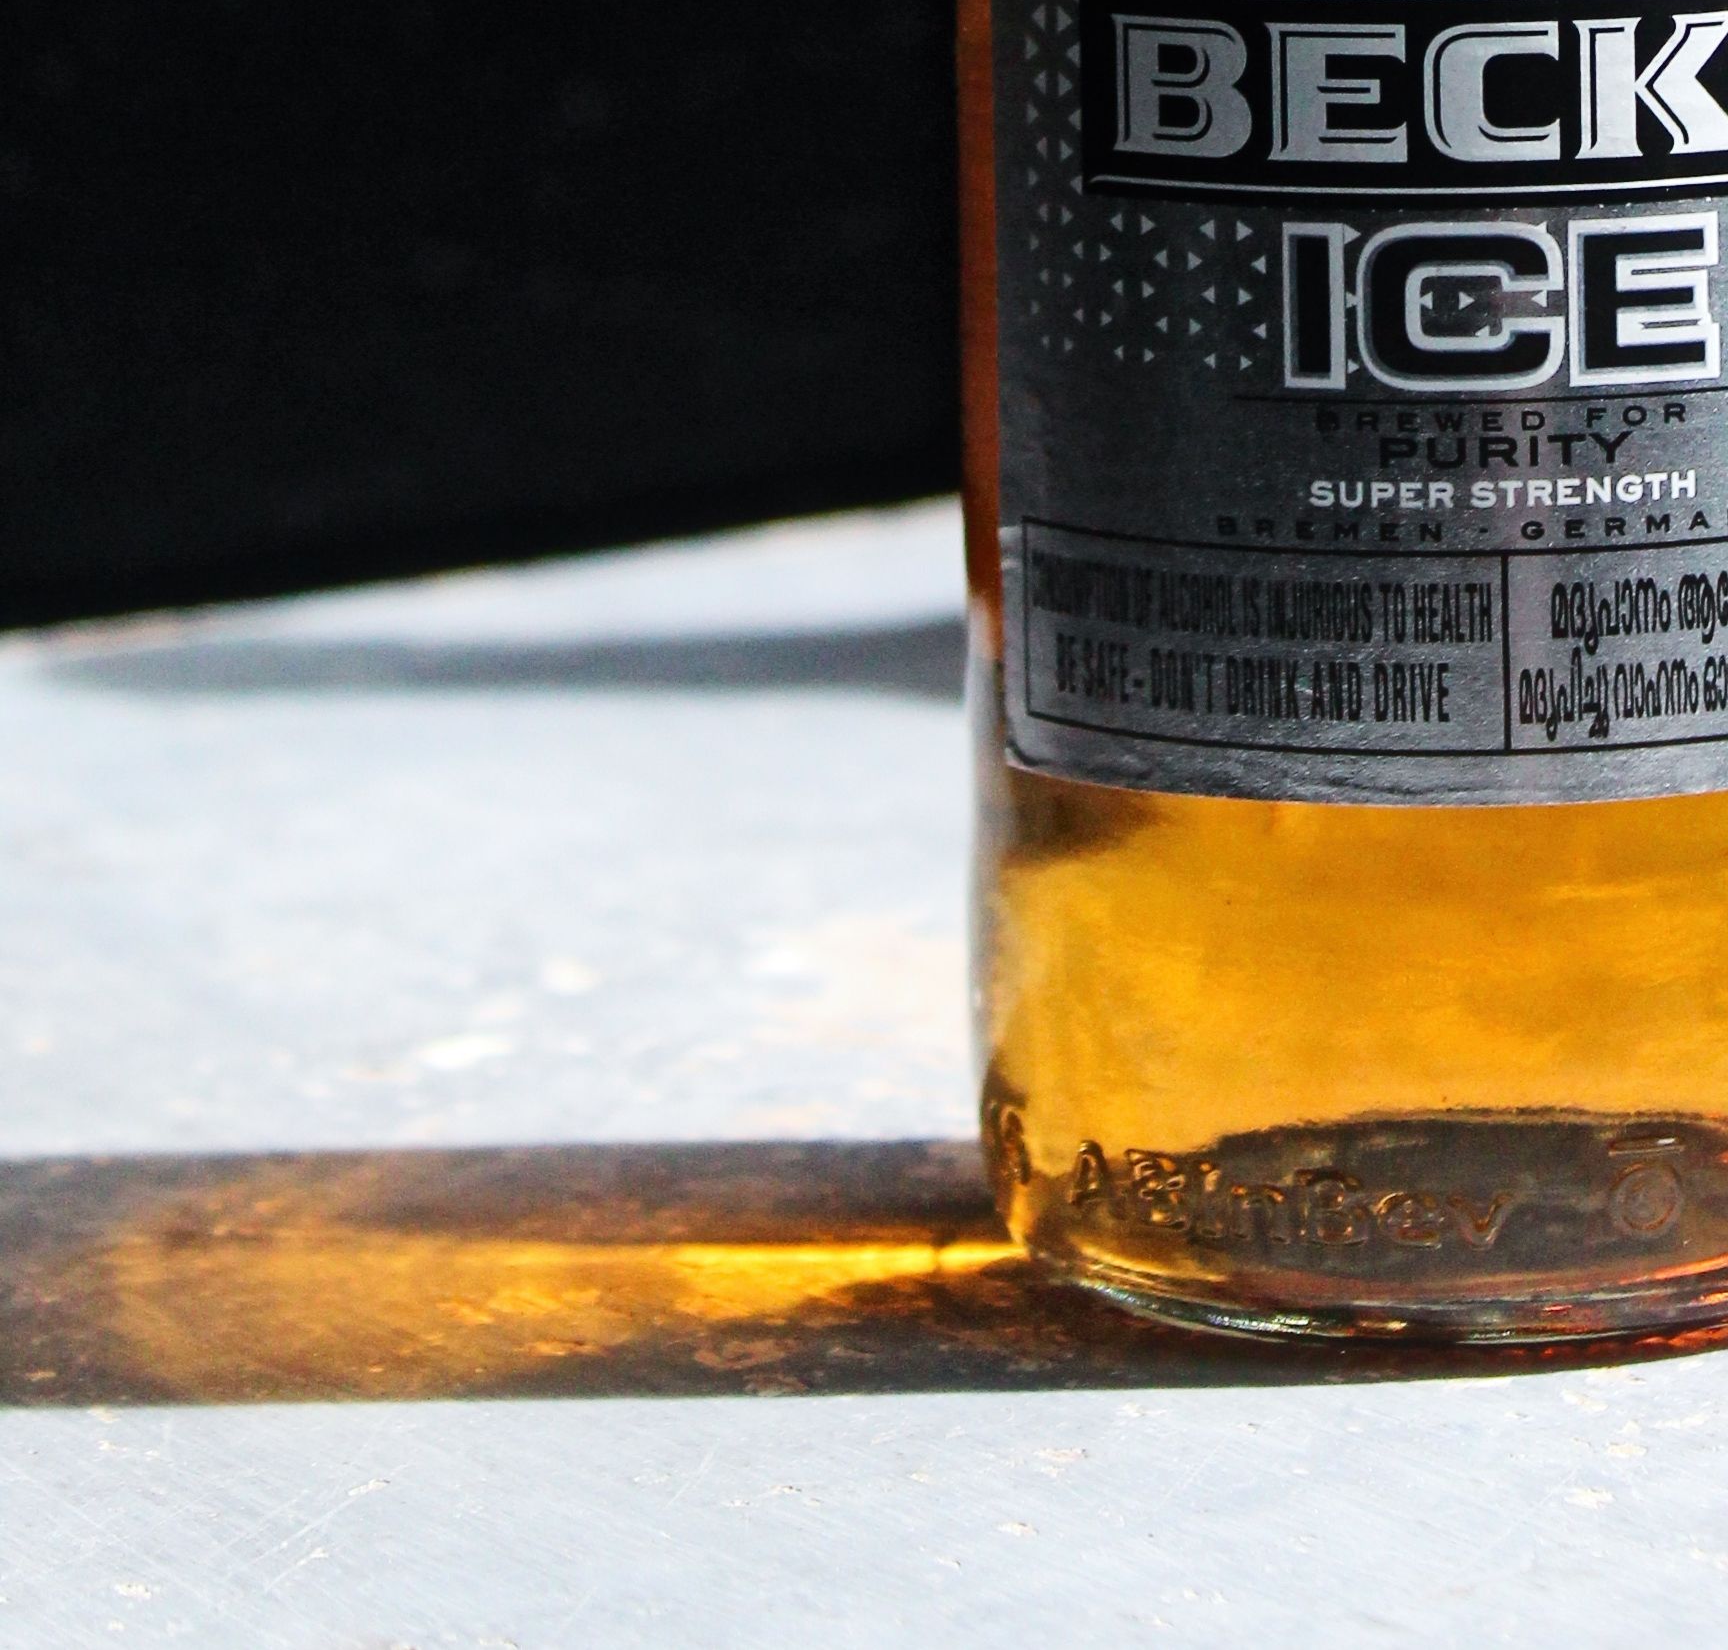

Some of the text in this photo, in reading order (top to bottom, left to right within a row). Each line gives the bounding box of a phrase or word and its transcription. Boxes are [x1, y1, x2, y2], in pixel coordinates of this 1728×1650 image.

[1282, 211, 1721, 391] ICE
[1315, 402, 1688, 434] BREWED FOR
[1378, 429, 1634, 470] PURITY
[1308, 468, 1698, 510] SUPER STRENGTH
[1216, 516, 1443, 543] BREMEN
[1379, 582, 1406, 643] TO
[1413, 582, 1493, 643] HEALTH
[1226, 655, 1300, 719] DRINK
[1311, 660, 1362, 721] AND
[1374, 662, 1450, 723] DRIVE
